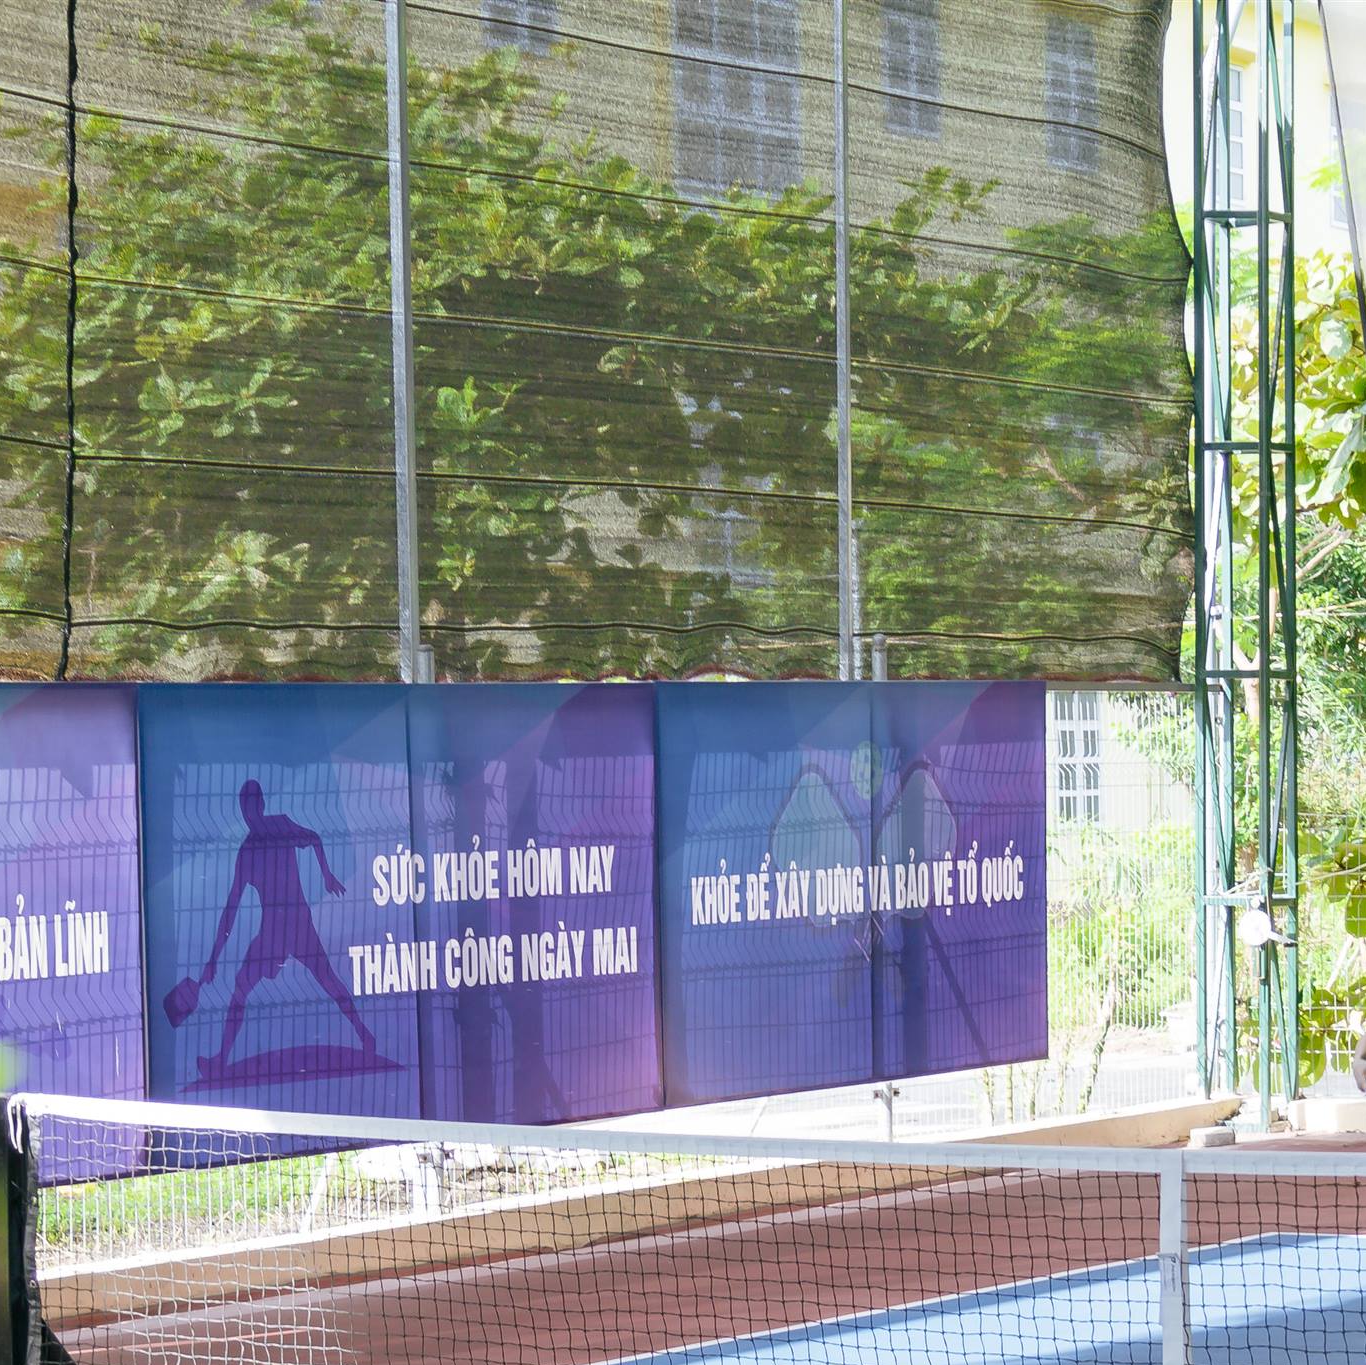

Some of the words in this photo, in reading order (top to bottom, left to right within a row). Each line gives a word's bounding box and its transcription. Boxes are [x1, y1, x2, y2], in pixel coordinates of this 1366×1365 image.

[372, 843, 426, 906] SỨC
[433, 834, 500, 903] KHỎE
[507, 838, 562, 899] HÔM
[569, 845, 615, 894] NAY
[691, 858, 742, 926] KHỎE
[746, 852, 771, 921] ĐỂ
[775, 860, 811, 920] XÂY
[815, 862, 864, 926] DỰNG
[867, 855, 892, 912] VÀ
[894, 847, 929, 910] BẢO
[933, 851, 954, 917] VỆ
[957, 840, 978, 905] TỔ
[981, 840, 1024, 908] QUỐC
[53, 899, 110, 977] LĨNH
[348, 932, 437, 996] THÀNH
[444, 927, 514, 989] CÔNG
[521, 920, 586, 982] NGÀY
[592, 926, 638, 976] MAI
